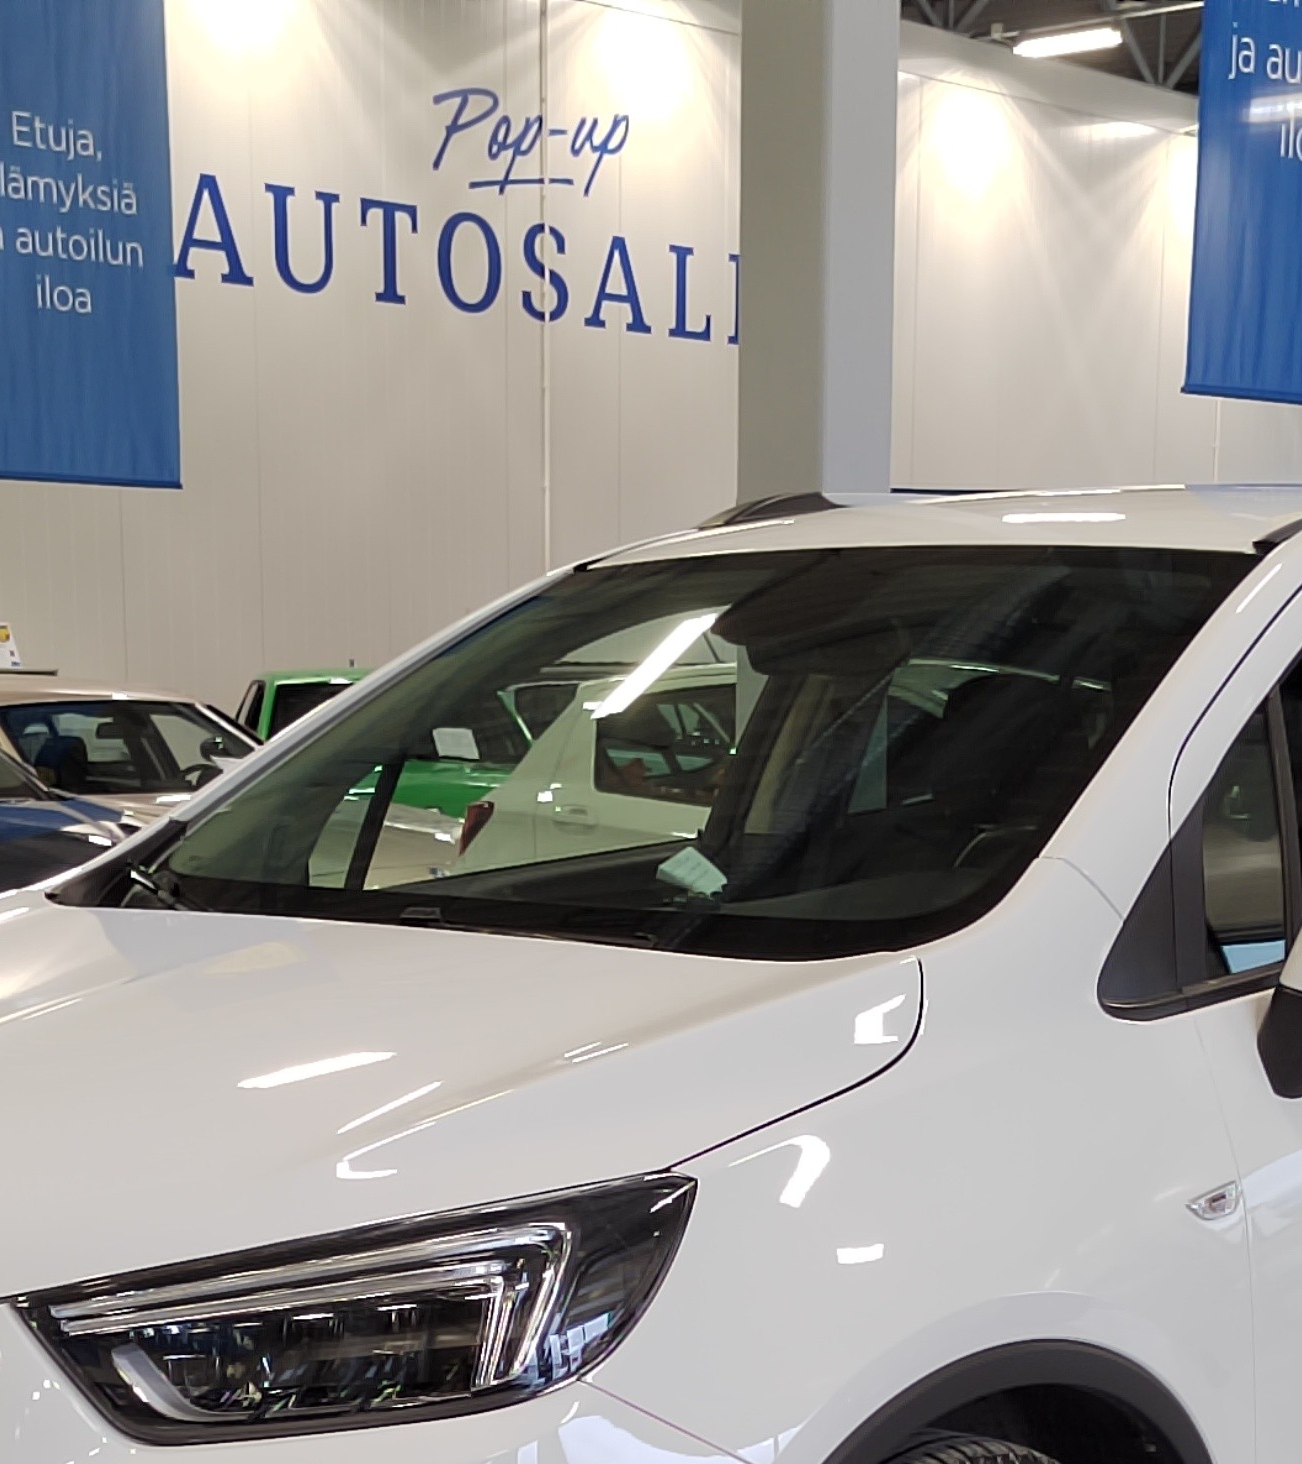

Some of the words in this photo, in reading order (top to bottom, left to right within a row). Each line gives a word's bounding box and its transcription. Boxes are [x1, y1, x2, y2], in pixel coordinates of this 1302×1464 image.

[1228, 21, 1255, 79] ja
[11, 110, 102, 162] Etuja,
[432, 87, 630, 197] Pop-up
[15, 225, 144, 268] autoilun
[36, 274, 92, 313] iloa
